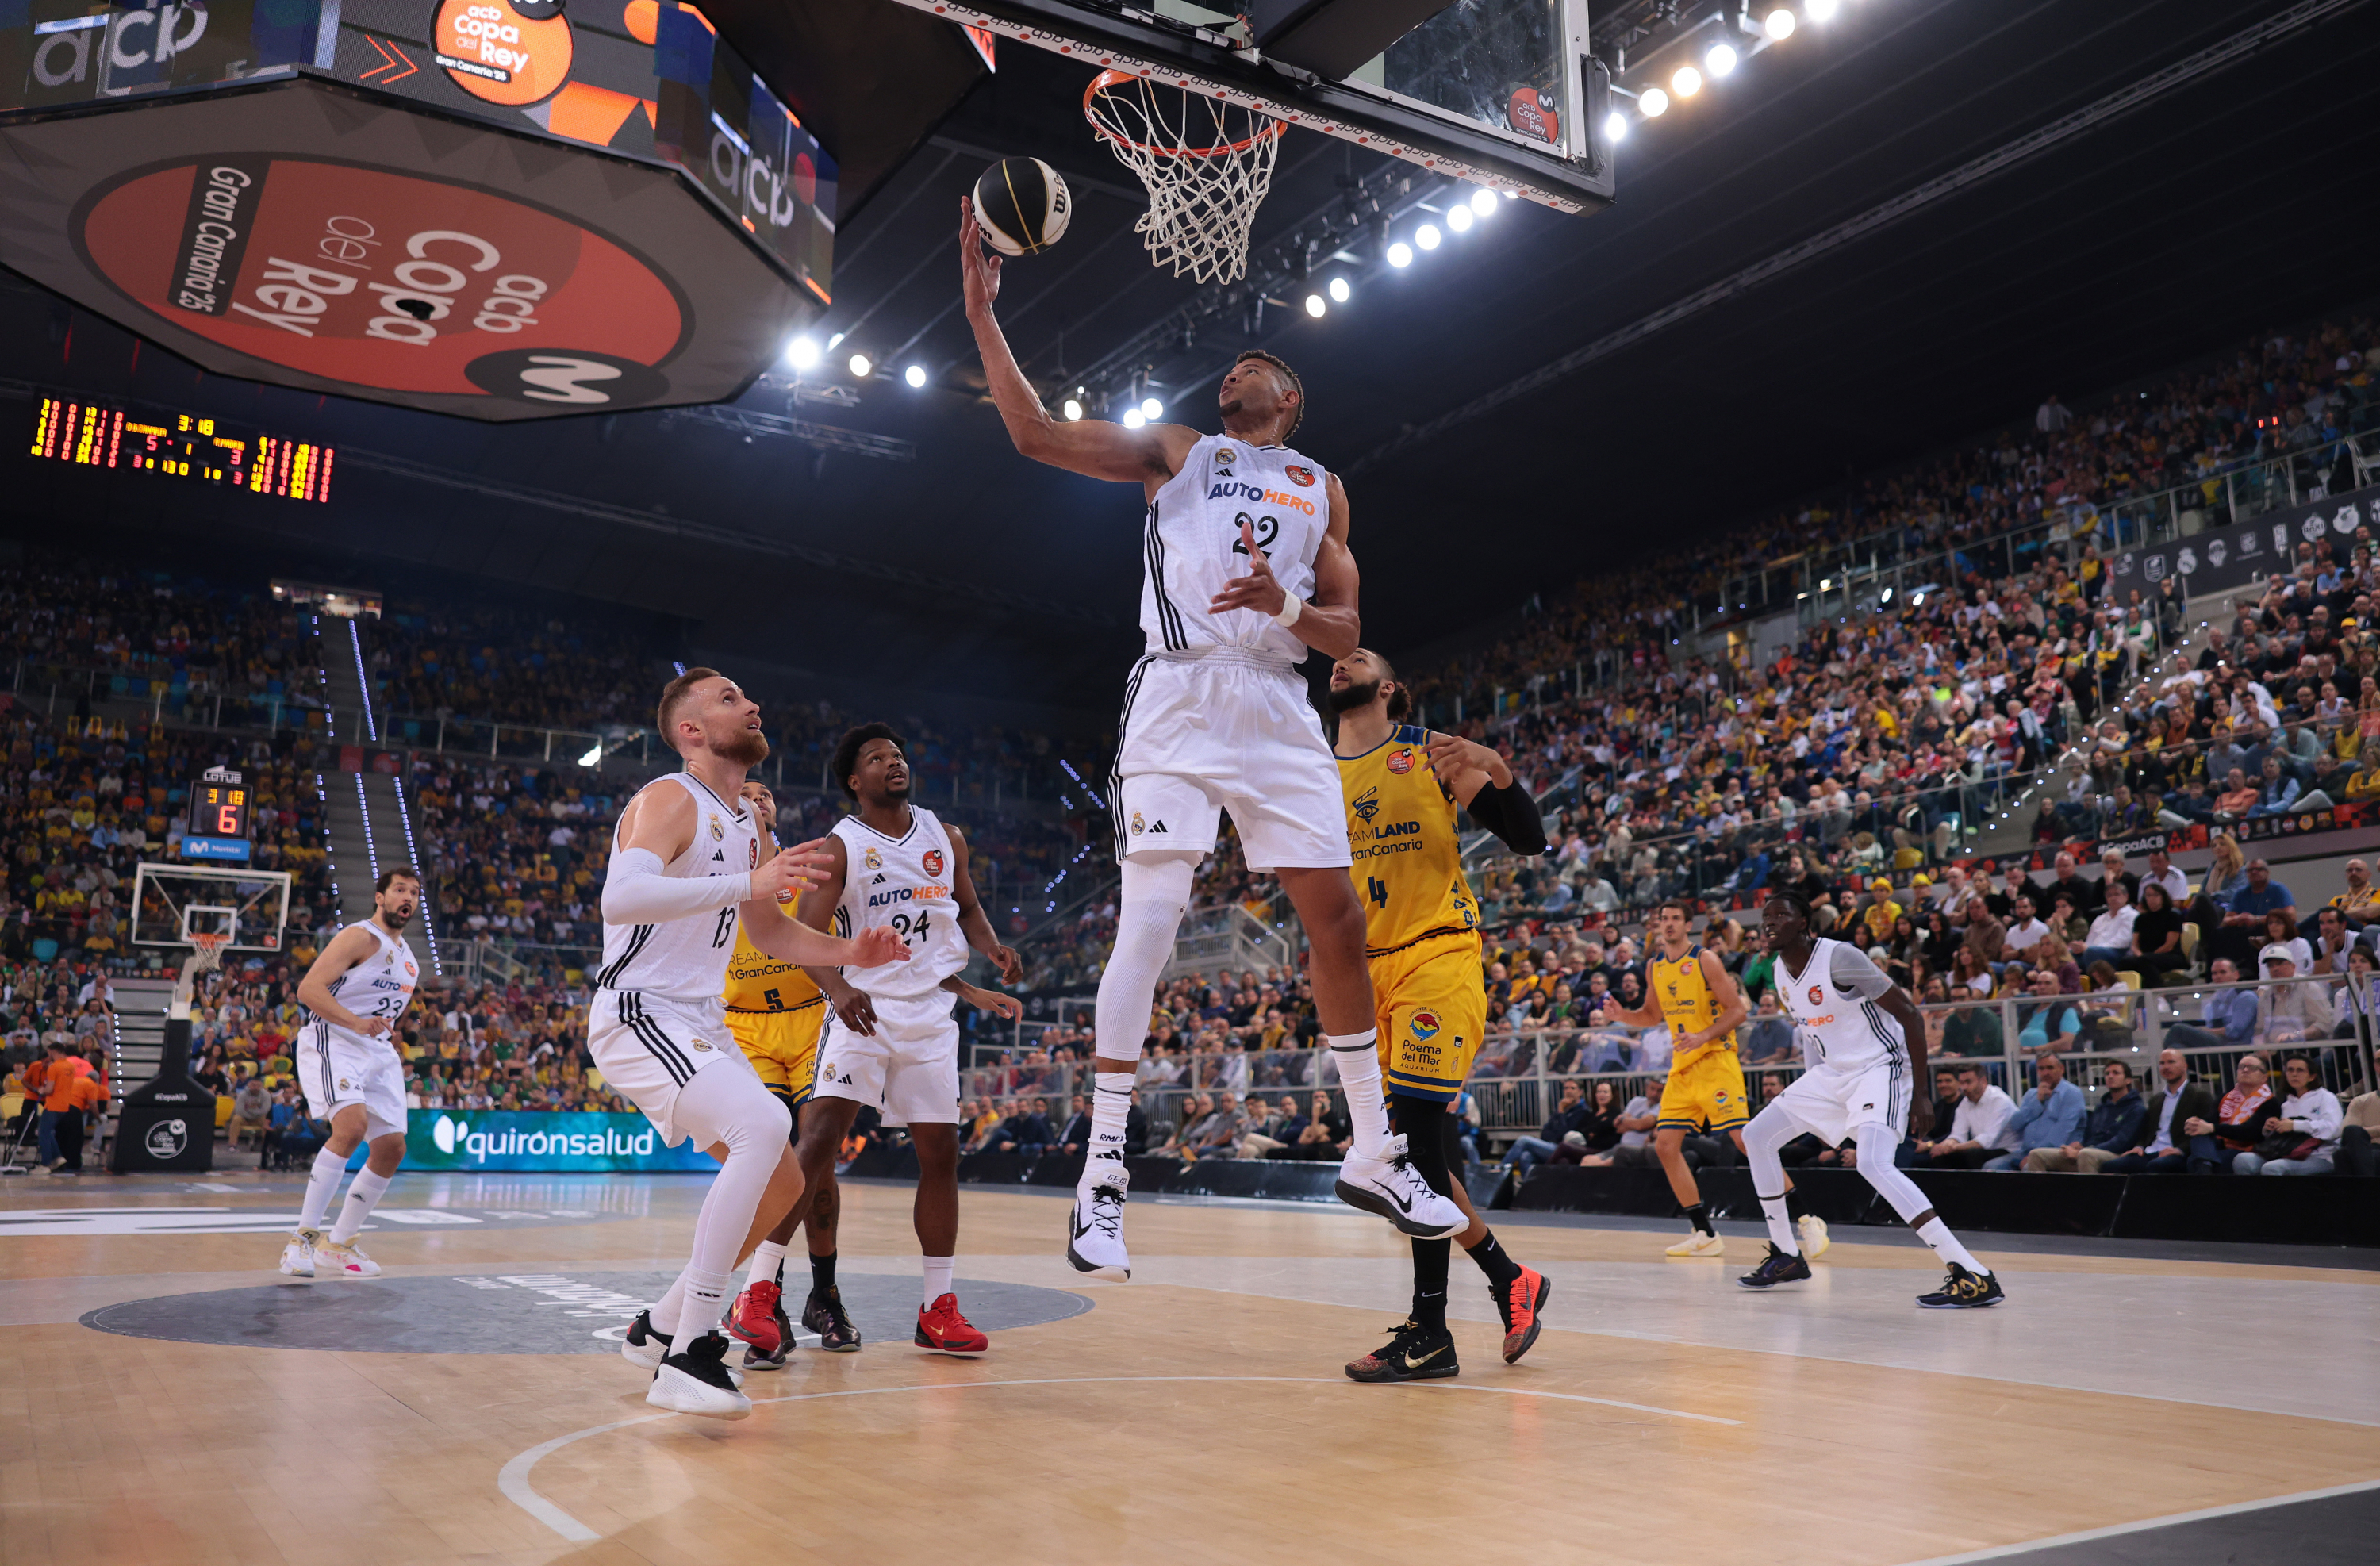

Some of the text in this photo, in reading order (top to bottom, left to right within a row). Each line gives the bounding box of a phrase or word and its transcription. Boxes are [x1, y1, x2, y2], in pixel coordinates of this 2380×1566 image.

[466, 5, 503, 21] acb
[454, 14, 520, 44] Copa
[435, 55, 457, 68] Gran
[456, 59, 494, 78] Canaria
[480, 40, 530, 74] Rey
[947, 2, 1587, 210] acb acb acb acb acb acb acb acb acb acb acb acb acb acb acb acb acb acb
[1518, 107, 1543, 122] Copa
[1522, 103, 1536, 112] acb
[1526, 131, 1542, 140] Canaria
[1530, 121, 1546, 135] Rey
[202, 167, 251, 222] Gran
[185, 221, 236, 293] Canaria
[232, 216, 382, 339] del Rey
[365, 230, 501, 347] Copa
[473, 274, 548, 334] acb
[177, 414, 215, 436] 3:18
[146, 434, 158, 451] 5
[186, 443, 194, 455] 1
[230, 448, 243, 466] 3
[132, 454, 143, 469] 3
[233, 470, 244, 485] 3
[1208, 482, 1315, 516] AUTOHERO
[1233, 512, 1279, 560] 22
[207, 788, 244, 806] 3 18
[218, 805, 237, 834] 6
[1351, 839, 1422, 861] ranCanaria
[869, 886, 949, 907] AUTOHERO
[1368, 876, 1388, 908] 4
[712, 906, 735, 949] 13
[892, 910, 931, 946] 24
[372, 997, 403, 1019] 23
[763, 988, 784, 1010] 5
[1403, 1039, 1442, 1055] Poema
[1400, 1063, 1440, 1073] AQUARIUM
[1401, 1052, 1441, 1065] del Mar
[465, 1127, 654, 1164] quirónsalud
